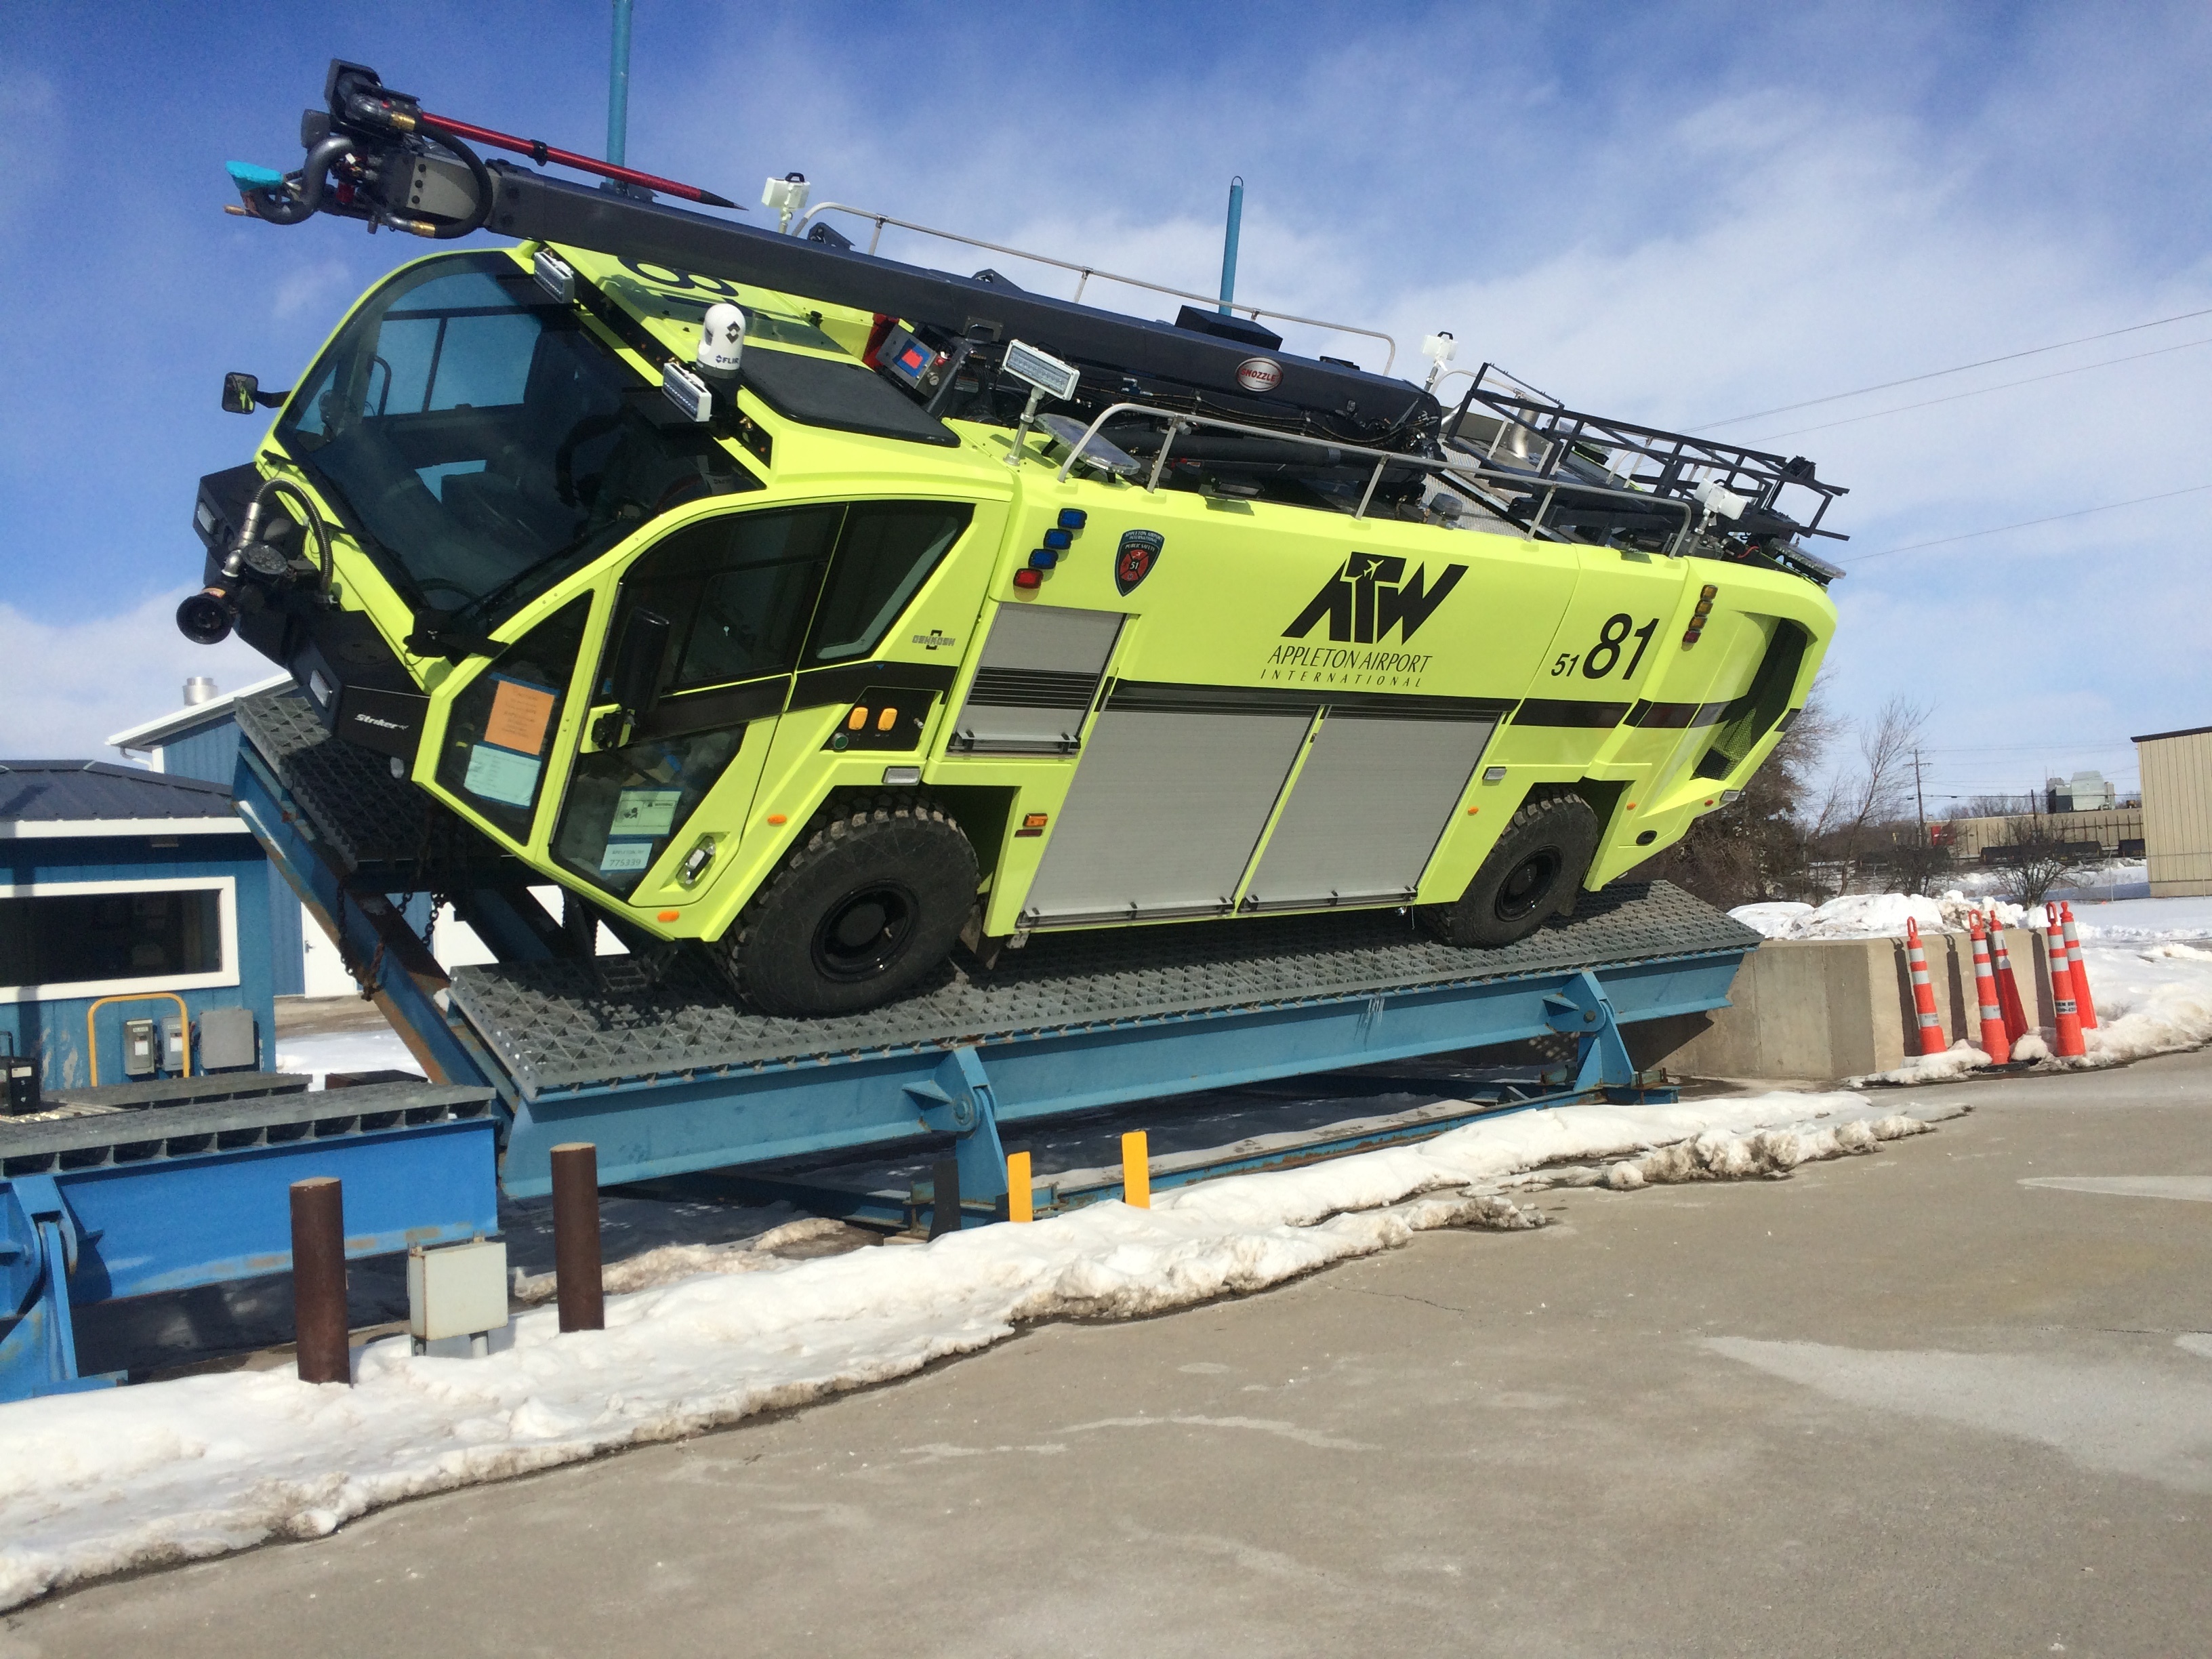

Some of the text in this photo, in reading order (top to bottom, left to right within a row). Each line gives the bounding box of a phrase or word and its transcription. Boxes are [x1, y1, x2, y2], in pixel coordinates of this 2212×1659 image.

[1241, 369, 1276, 382] SNOZZLE
[1147, 532, 1163, 542] AIRPORT
[1141, 544, 1155, 552] SAFETY
[1130, 562, 1139, 570] 51
[1281, 551, 1469, 646] ATW
[1551, 613, 1660, 680] 51 81
[1267, 645, 1433, 673] APPLETON AIRPORT
[1261, 668, 1422, 687] INTERNATIONAL
[354, 714, 397, 729] Striker
[610, 859, 641, 867] 775339
